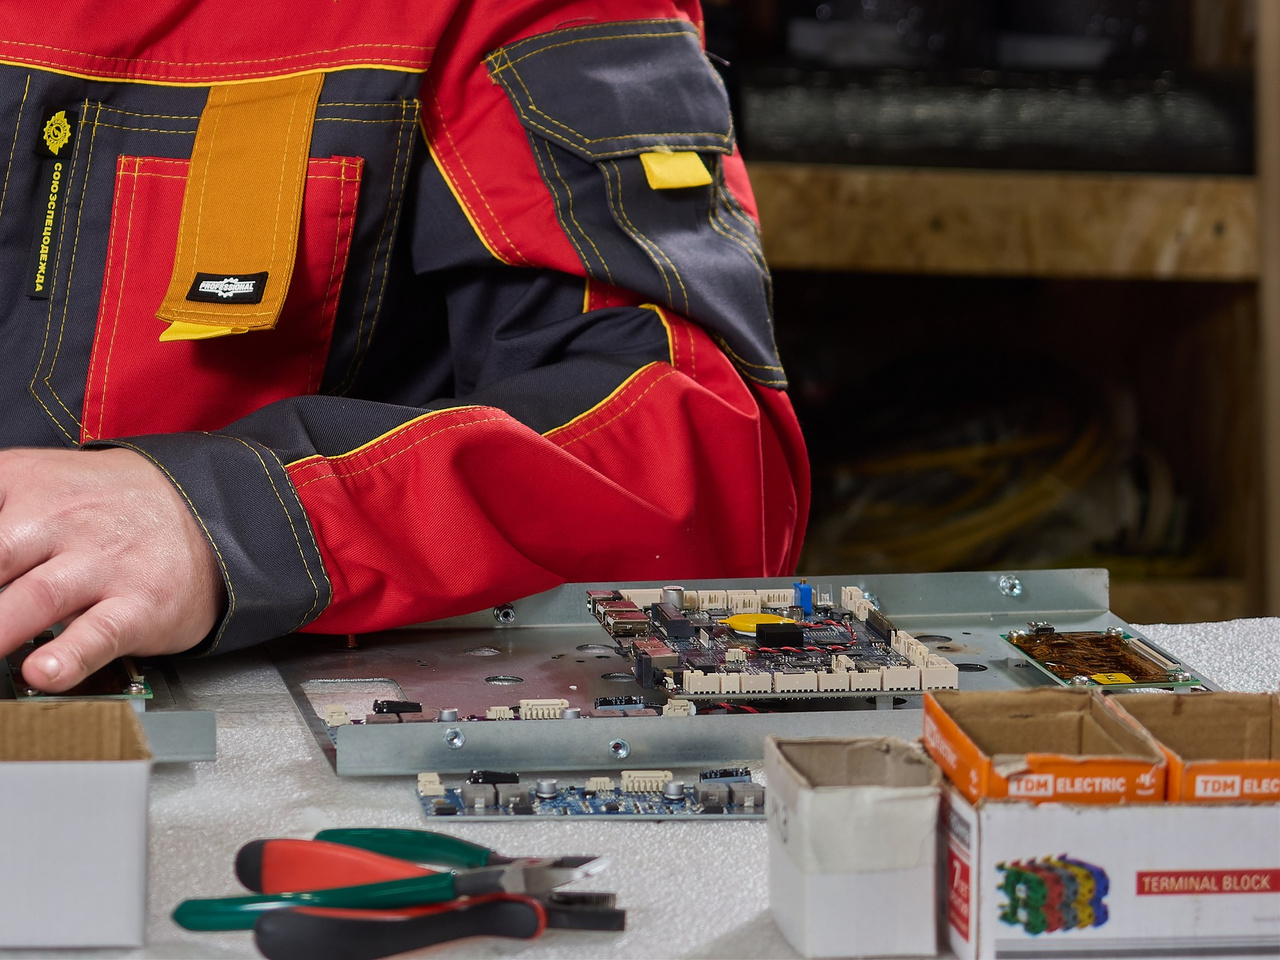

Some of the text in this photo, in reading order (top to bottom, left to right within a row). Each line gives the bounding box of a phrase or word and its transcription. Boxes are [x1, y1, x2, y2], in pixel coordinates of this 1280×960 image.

[35, 162, 62, 292] СОЮЗСПЕЦОДЕЖДА
[200, 281, 255, 292] PROFESSIONAL
[1013, 777, 1126, 793] TDM ELECTRIC
[1200, 778, 1237, 794] TDM
[1142, 873, 1271, 893] TERMINAL BLOCK
